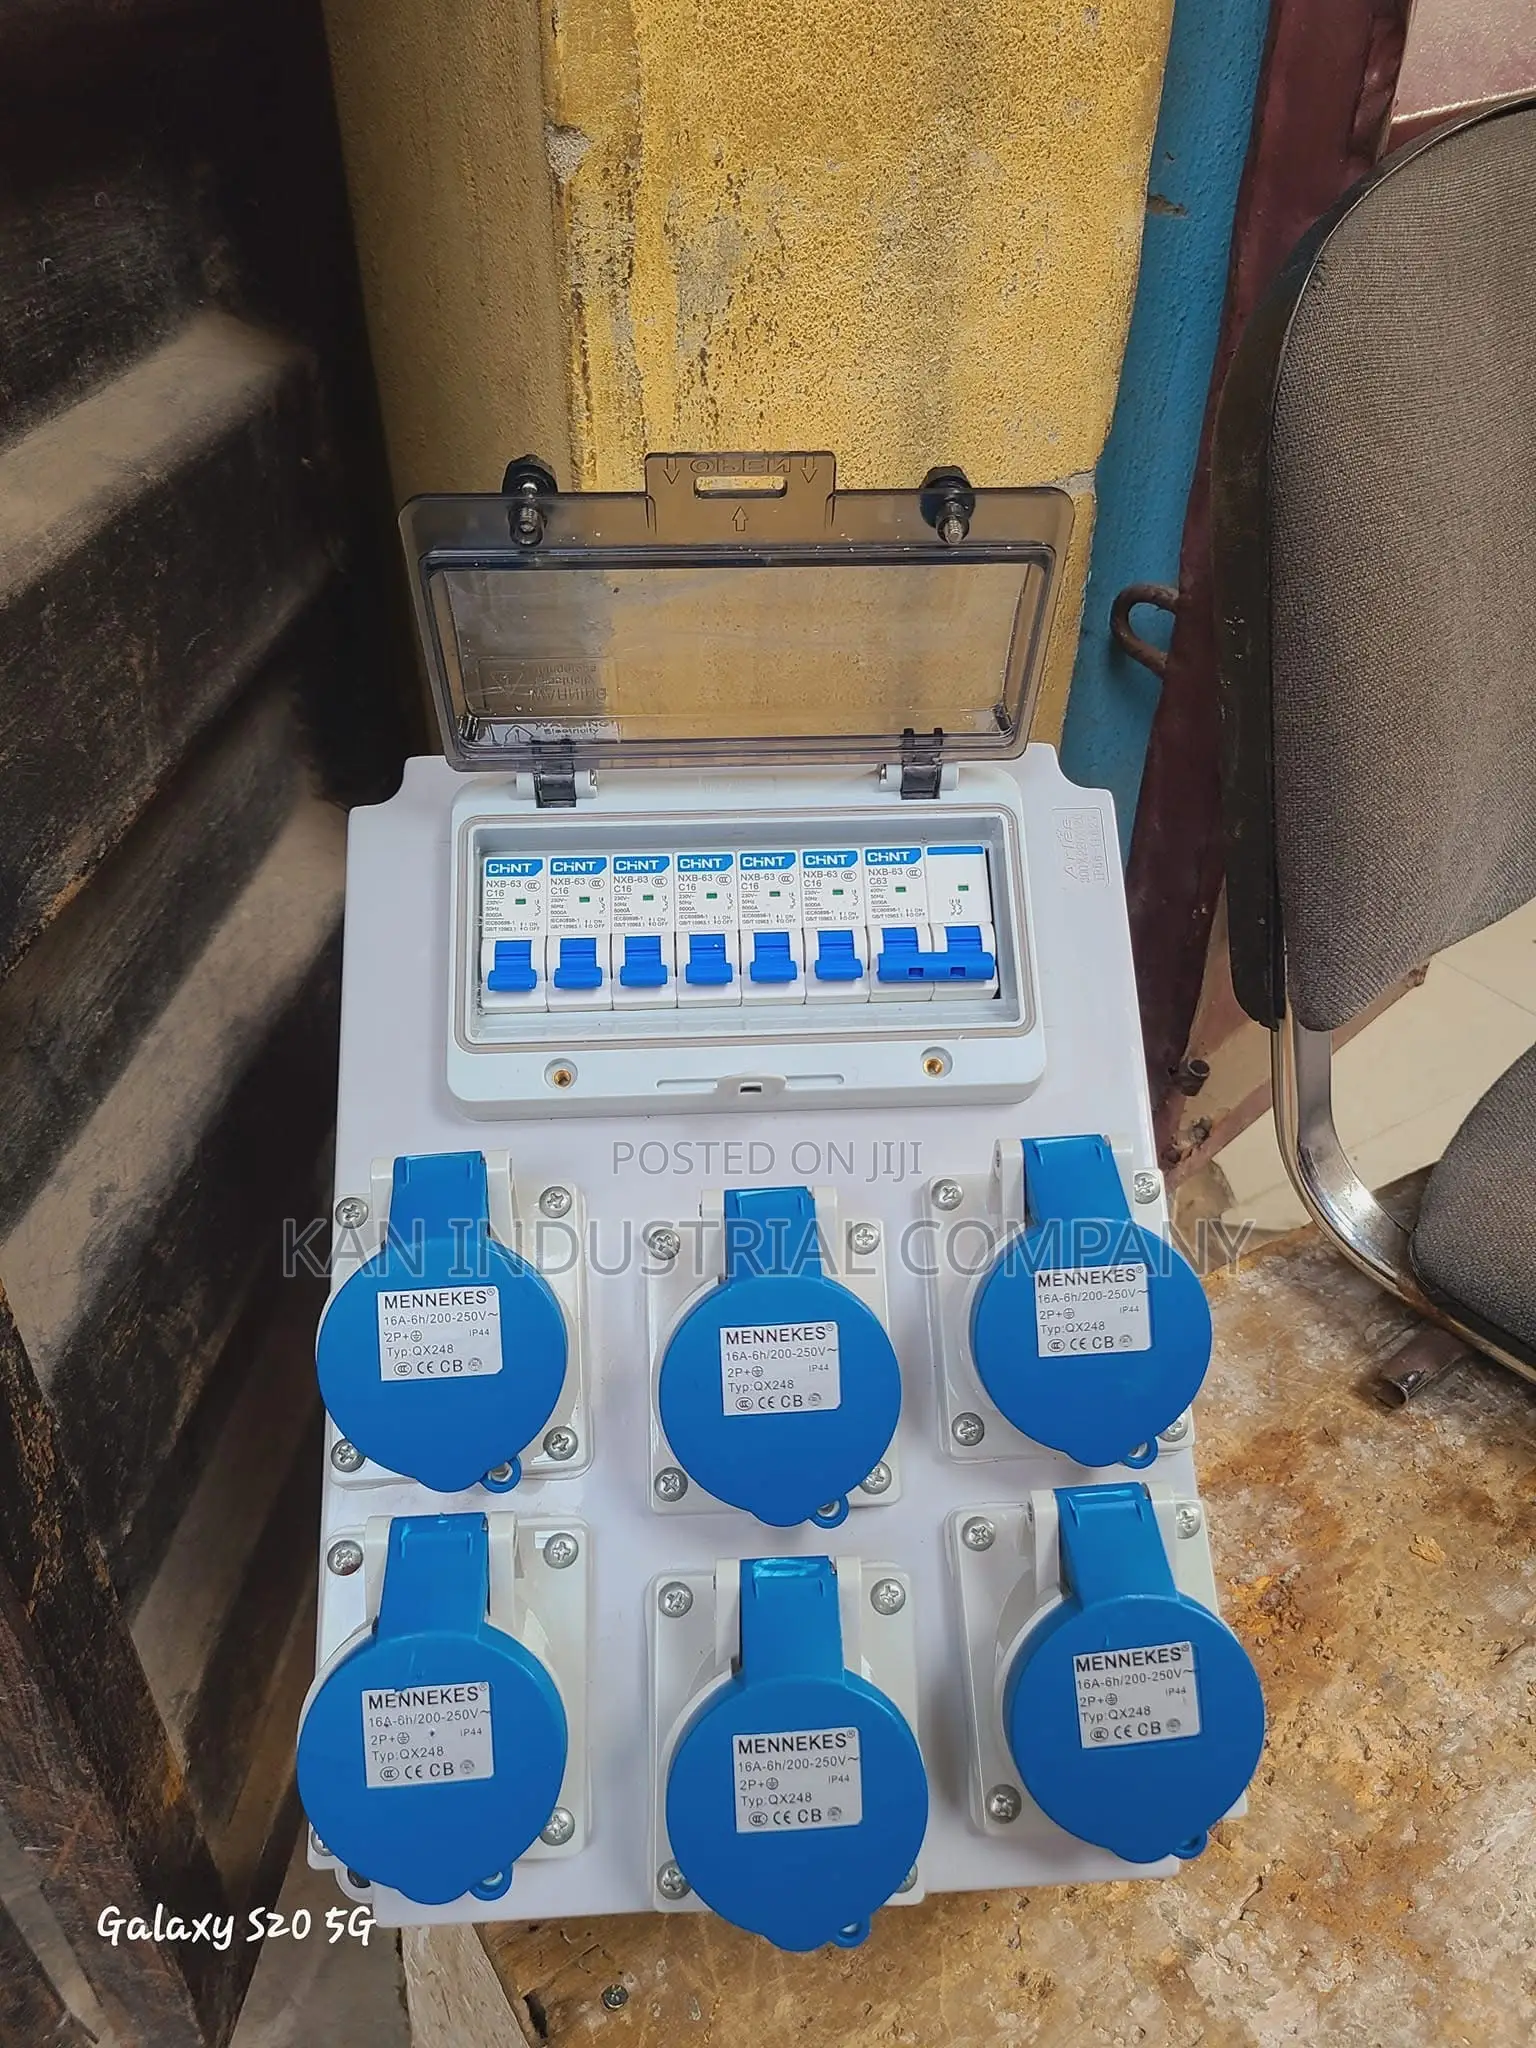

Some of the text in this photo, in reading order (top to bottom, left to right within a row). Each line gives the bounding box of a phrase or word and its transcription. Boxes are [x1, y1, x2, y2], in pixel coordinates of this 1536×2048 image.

[803, 870, 838, 879] NXB-63
[868, 868, 903, 876] NXB-63
[614, 876, 649, 884] NXB-63
[678, 874, 713, 882] NXB-63
[740, 873, 776, 881] NXB-63
[869, 877, 888, 885] C63
[486, 880, 522, 889] NXB-63
[550, 878, 586, 886] NXB-63
[740, 882, 760, 890] C16
[803, 880, 822, 888] C16
[550, 887, 569, 895] C16
[614, 885, 632, 893] C16
[678, 883, 697, 891] C16
[486, 890, 505, 898] C16
[1119, 1305, 1140, 1314] IP44
[469, 1328, 490, 1337] IP44
[1040, 1321, 1105, 1336] Typ:QX248
[1069, 1337, 1087, 1351] CE
[1091, 1336, 1114, 1350] CB
[386, 1344, 454, 1359] Typ:QX248
[416, 1361, 435, 1375] CE
[440, 1359, 463, 1373] CB
[808, 1364, 829, 1373] IP44
[728, 1380, 794, 1395] Typ:QX248
[758, 1396, 775, 1409] CE
[780, 1394, 803, 1408] CB
[1165, 1687, 1187, 1697] IP44
[1081, 1705, 1151, 1724] Typ:QX248
[460, 1727, 482, 1737] IP44
[1113, 1724, 1133, 1740] CE
[1137, 1721, 1161, 1737] CB
[372, 1746, 444, 1764] Typ:QX248
[404, 1764, 423, 1780] CE
[429, 1761, 454, 1777] CB
[828, 1775, 850, 1784] IP44
[741, 1792, 813, 1808] Typ:QX248
[773, 1810, 792, 1825] CE
[797, 1808, 822, 1824] CB
